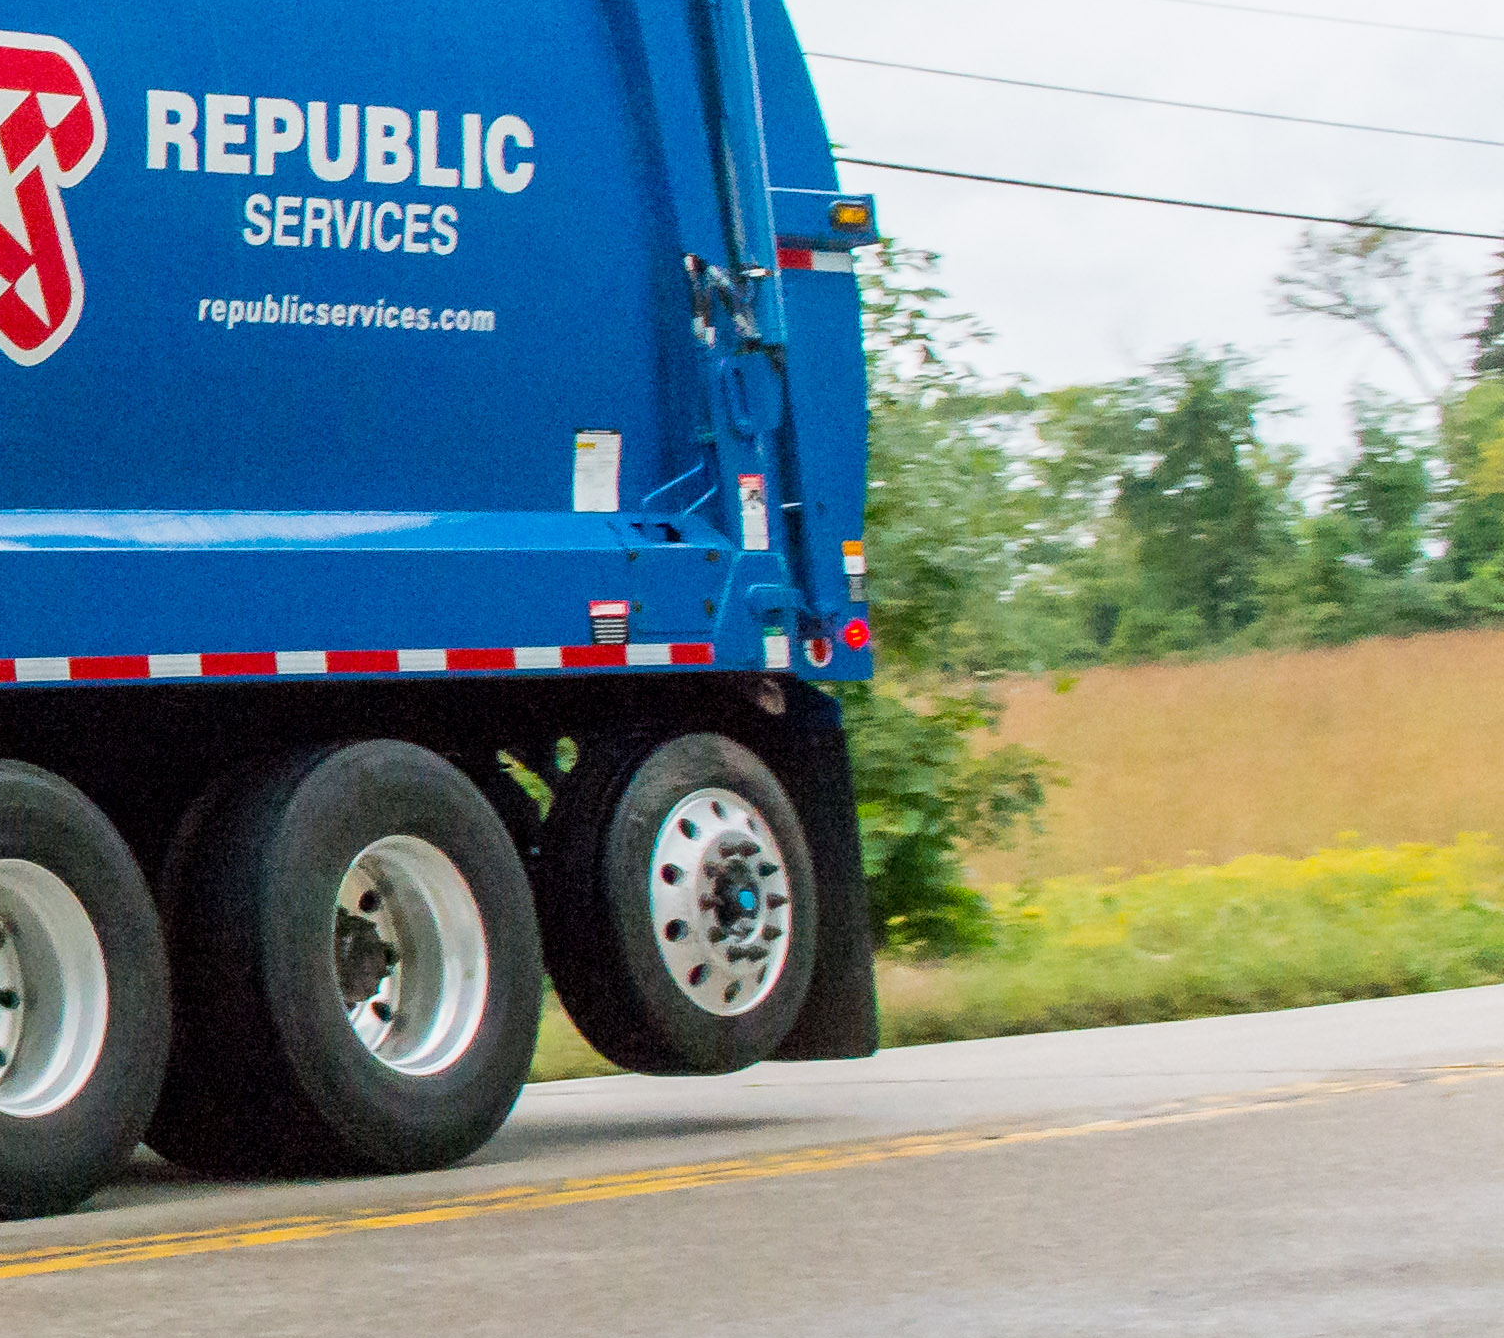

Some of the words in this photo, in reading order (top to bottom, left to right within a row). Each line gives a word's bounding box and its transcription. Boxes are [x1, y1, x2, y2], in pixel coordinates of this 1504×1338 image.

[146, 89, 536, 194] REPUBLIC
[242, 193, 460, 257] SERVICES
[197, 293, 496, 333] republicservices.com
